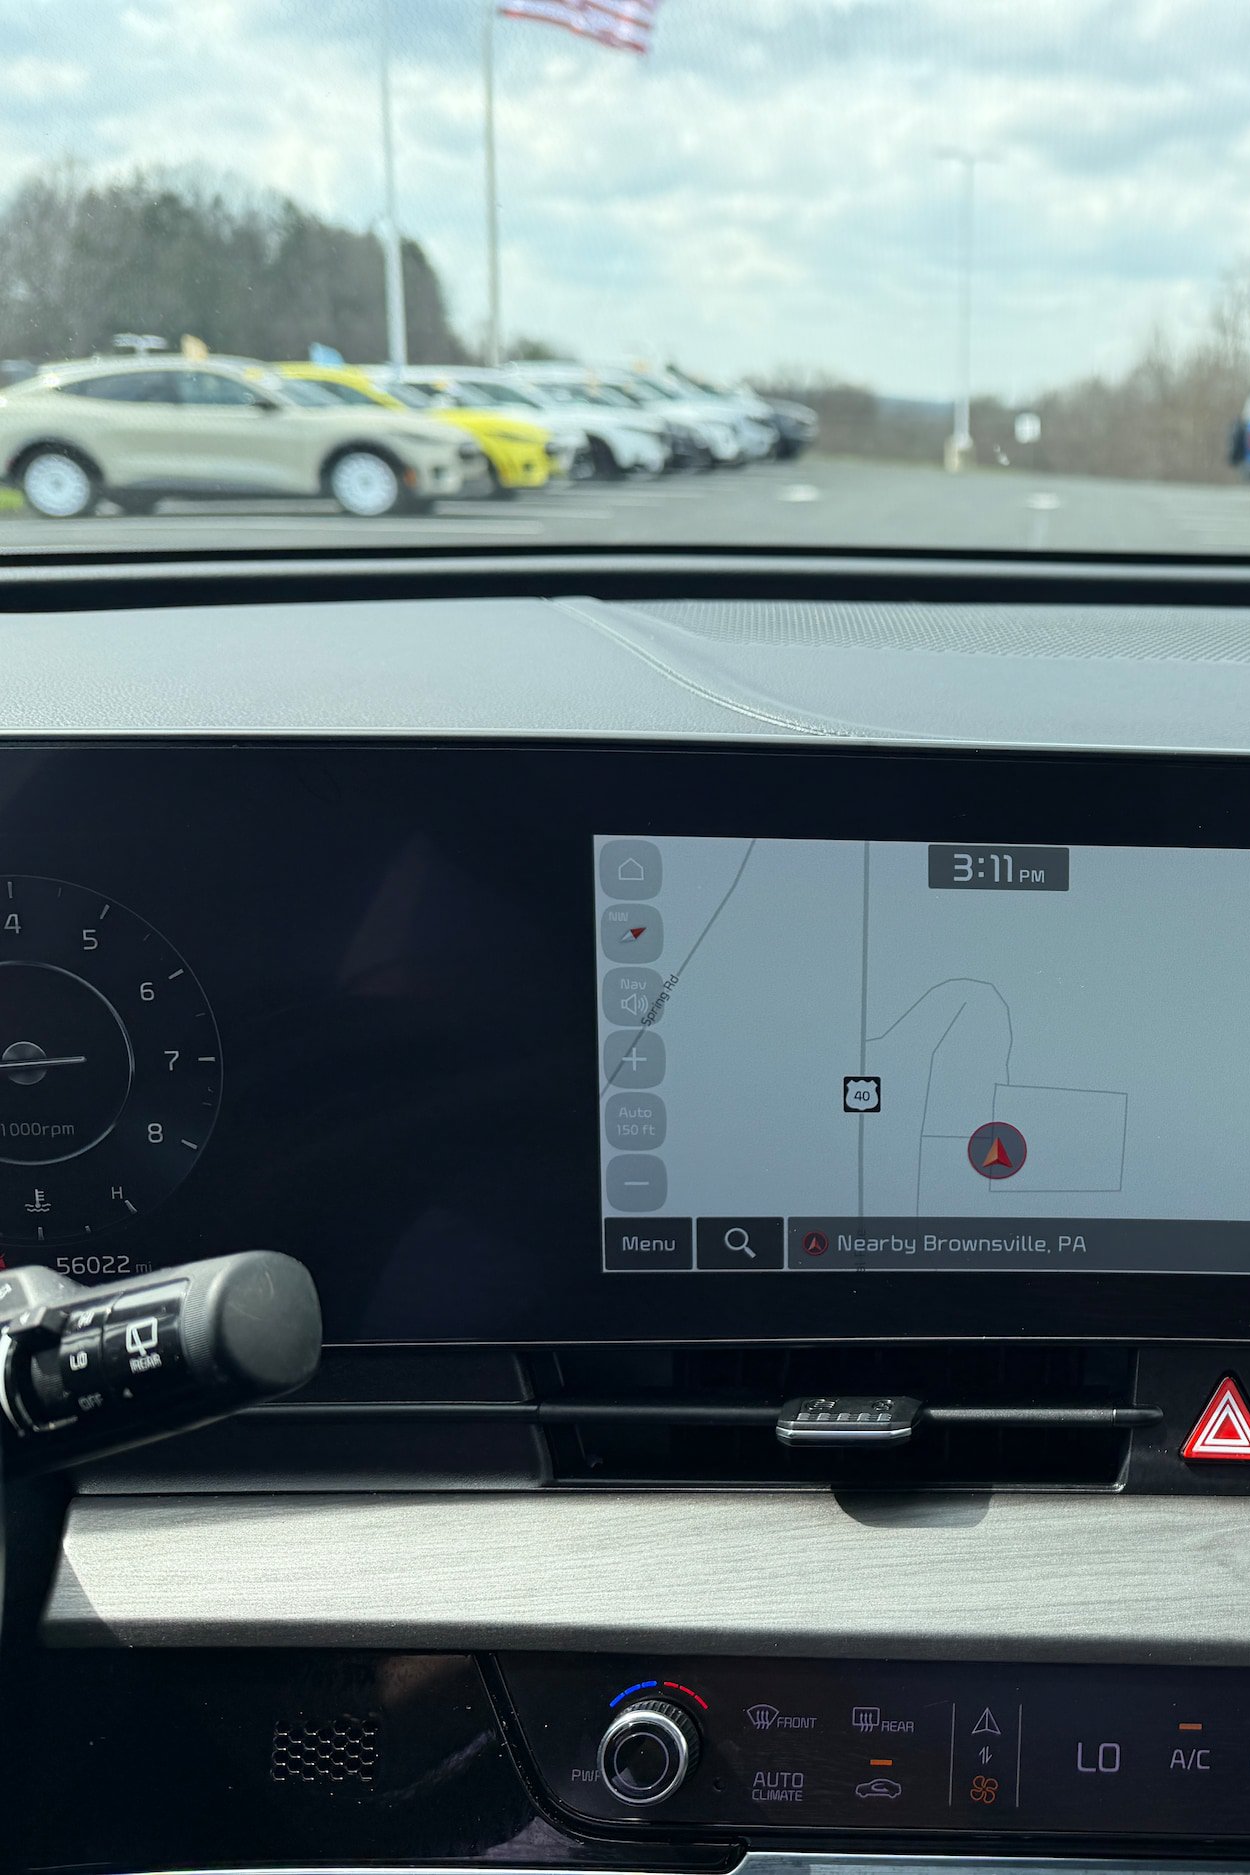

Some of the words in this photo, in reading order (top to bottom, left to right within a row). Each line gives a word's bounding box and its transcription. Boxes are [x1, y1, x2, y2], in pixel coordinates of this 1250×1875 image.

[953, 853, 1013, 883] 3:11
[1019, 869, 1045, 884] PM
[3, 913, 22, 934] 4
[608, 911, 630, 922] NW
[82, 929, 99, 950] 5
[139, 981, 156, 1001] 6
[620, 979, 647, 990] Nav
[640, 991, 671, 1027] Spring
[663, 974, 679, 992] Rd
[163, 1050, 180, 1071] 7
[854, 1090, 871, 1102] 40
[618, 1107, 653, 1119] Auto
[147, 1123, 164, 1144] 8
[616, 1124, 639, 1136] 150
[642, 1124, 656, 1136] ft
[111, 1186, 124, 1200] H
[621, 1235, 676, 1252] Menu
[837, 1234, 917, 1255] Nearby
[923, 1234, 1052, 1255] Brownsville,
[1058, 1235, 1088, 1253] PA
[56, 1255, 131, 1275] 56022
[135, 1260, 152, 1273] mi
[69, 1351, 88, 1372] LO
[129, 1352, 163, 1375] REAR
[777, 1716, 818, 1729] FRONT
[881, 1720, 915, 1733] REAR
[1076, 1741, 1121, 1773] LO
[1169, 1748, 1211, 1770] A/C
[752, 1770, 805, 1789] AUTO
[751, 1788, 804, 1802] CLIMATE
